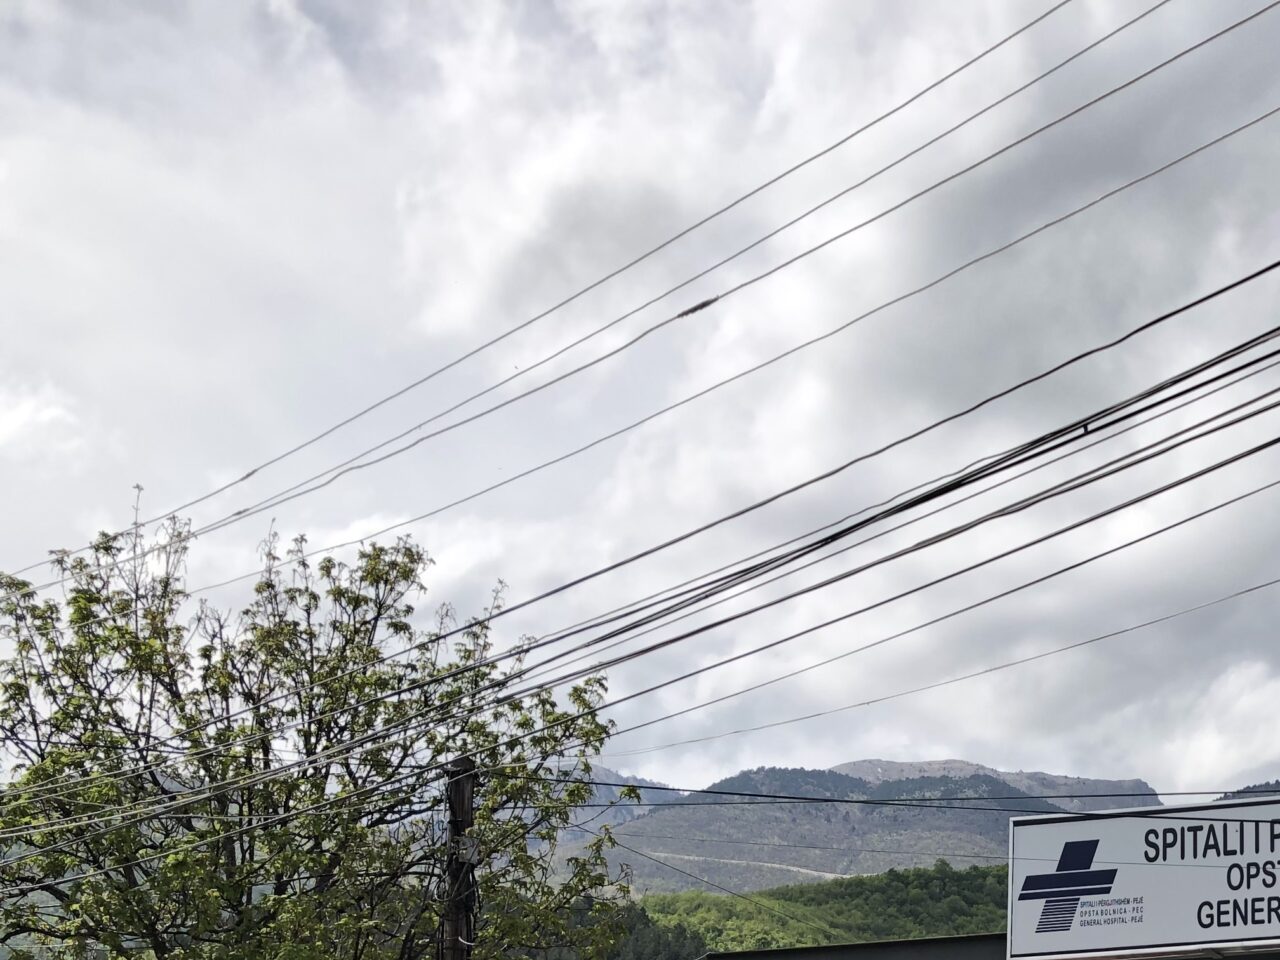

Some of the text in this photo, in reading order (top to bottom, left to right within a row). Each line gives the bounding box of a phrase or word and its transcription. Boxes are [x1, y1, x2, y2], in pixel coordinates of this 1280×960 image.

[1144, 820, 1244, 862] SPITALI
[1080, 909, 1099, 918] OPSTA
[1080, 919, 1103, 927] GENERAL
